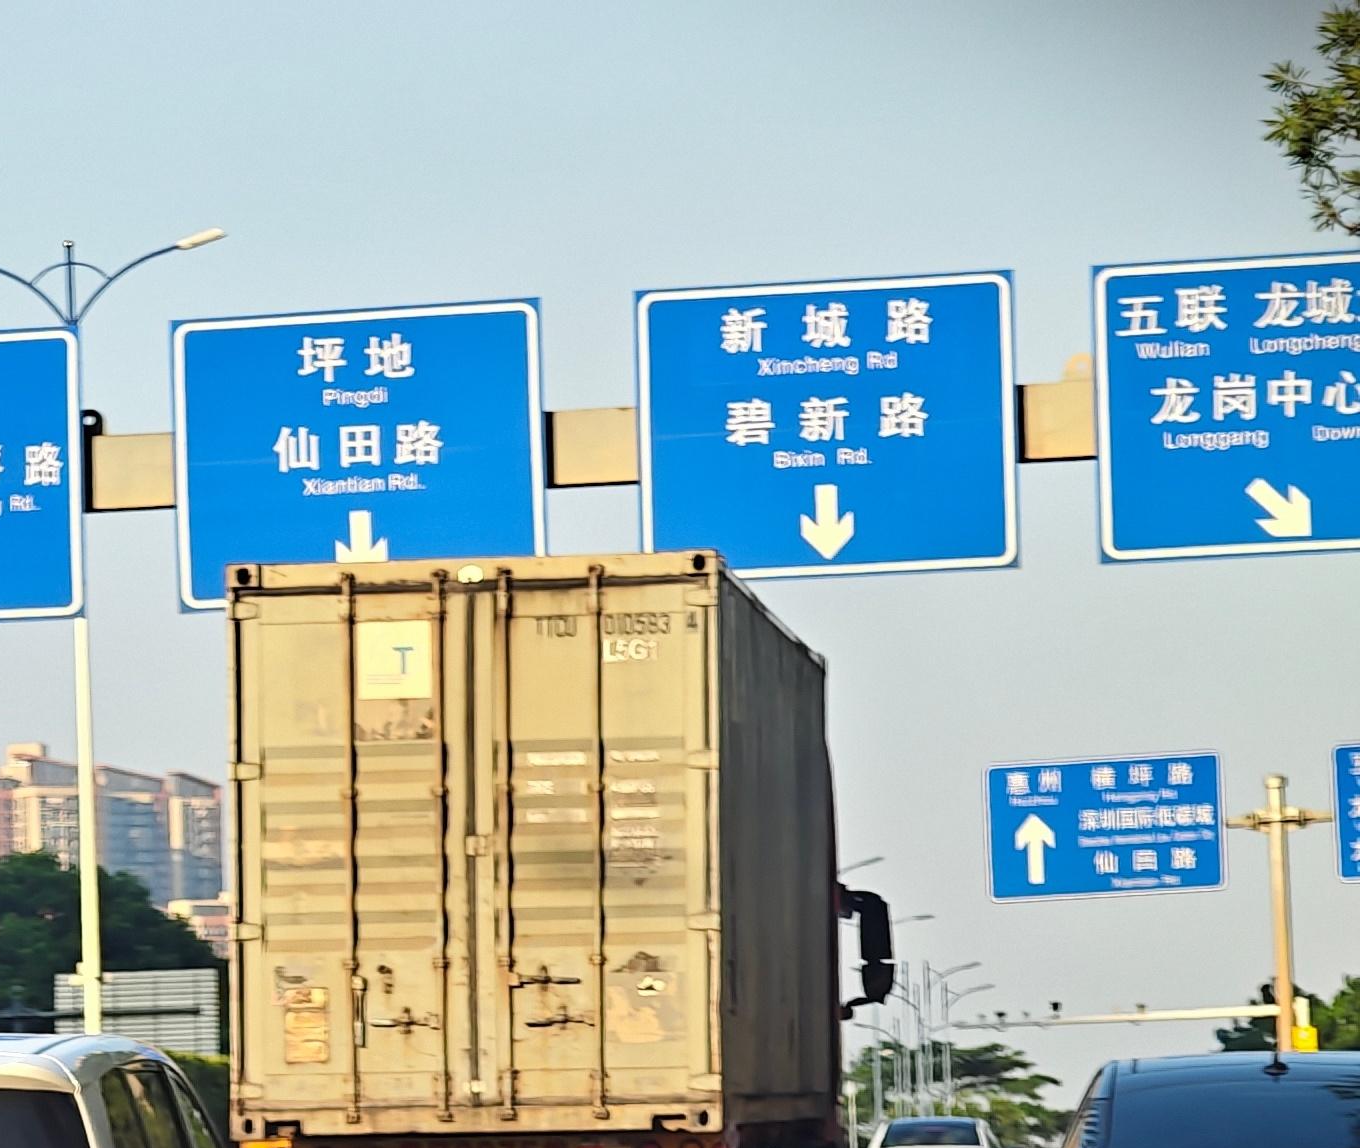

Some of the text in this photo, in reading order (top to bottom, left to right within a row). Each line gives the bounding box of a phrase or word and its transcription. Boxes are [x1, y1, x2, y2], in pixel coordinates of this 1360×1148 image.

[1115, 277, 1360, 337] 五联 龙城
[720, 297, 933, 354] 新城路
[297, 333, 415, 382] 坪地
[1135, 340, 1210, 359] Wulian
[756, 354, 859, 377] Xincheng
[322, 387, 388, 408] Pingdi
[724, 392, 929, 447] 碧新路
[273, 420, 444, 473] 仙田路
[1163, 429, 1269, 450] Longgang
[773, 449, 825, 469] Bixin
[302, 475, 385, 497] Xiantian
